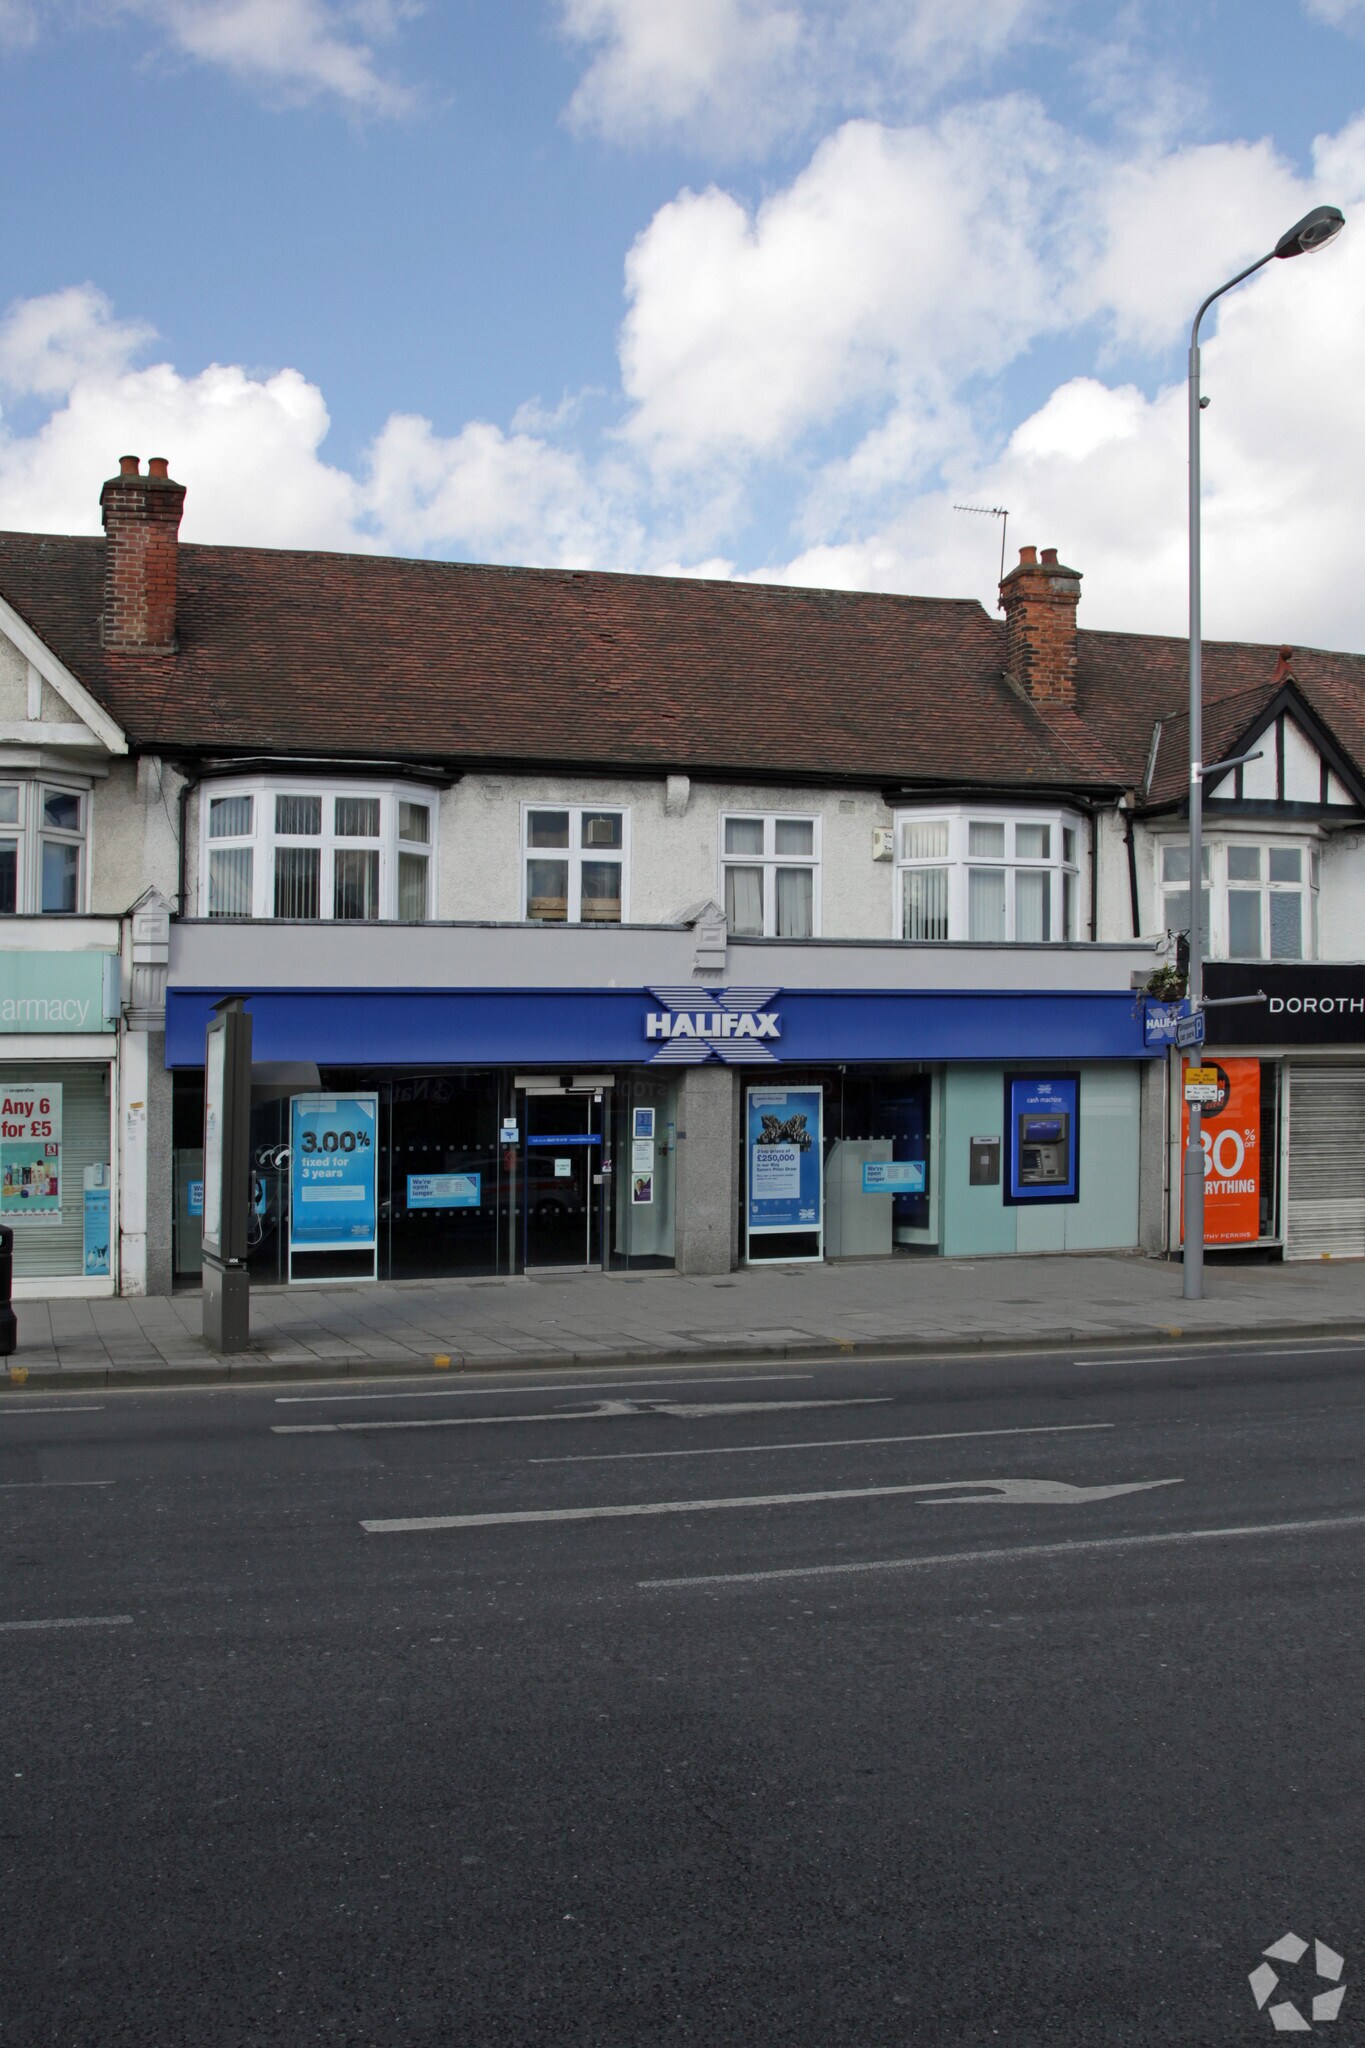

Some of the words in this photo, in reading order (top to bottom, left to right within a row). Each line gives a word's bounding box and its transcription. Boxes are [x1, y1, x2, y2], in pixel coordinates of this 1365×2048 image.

[2, 999, 90, 1027] armacy
[1269, 997, 1364, 1013] DOROTH
[646, 1013, 781, 1037] HALIFAX
[1196, 1017, 1202, 1038] P
[2, 1099, 34, 1118] Any
[40, 1098, 50, 1114] 6
[1, 1121, 26, 1137] for
[31, 1121, 52, 1137] £5
[302, 1131, 371, 1153] 3.00%
[302, 1158, 329, 1167] fixed
[333, 1157, 349, 1167] for
[757, 1154, 795, 1162] £250,000
[302, 1169, 309, 1178] 3
[312, 1170, 343, 1180] years
[1204, 1180, 1255, 1195] RYTHING
